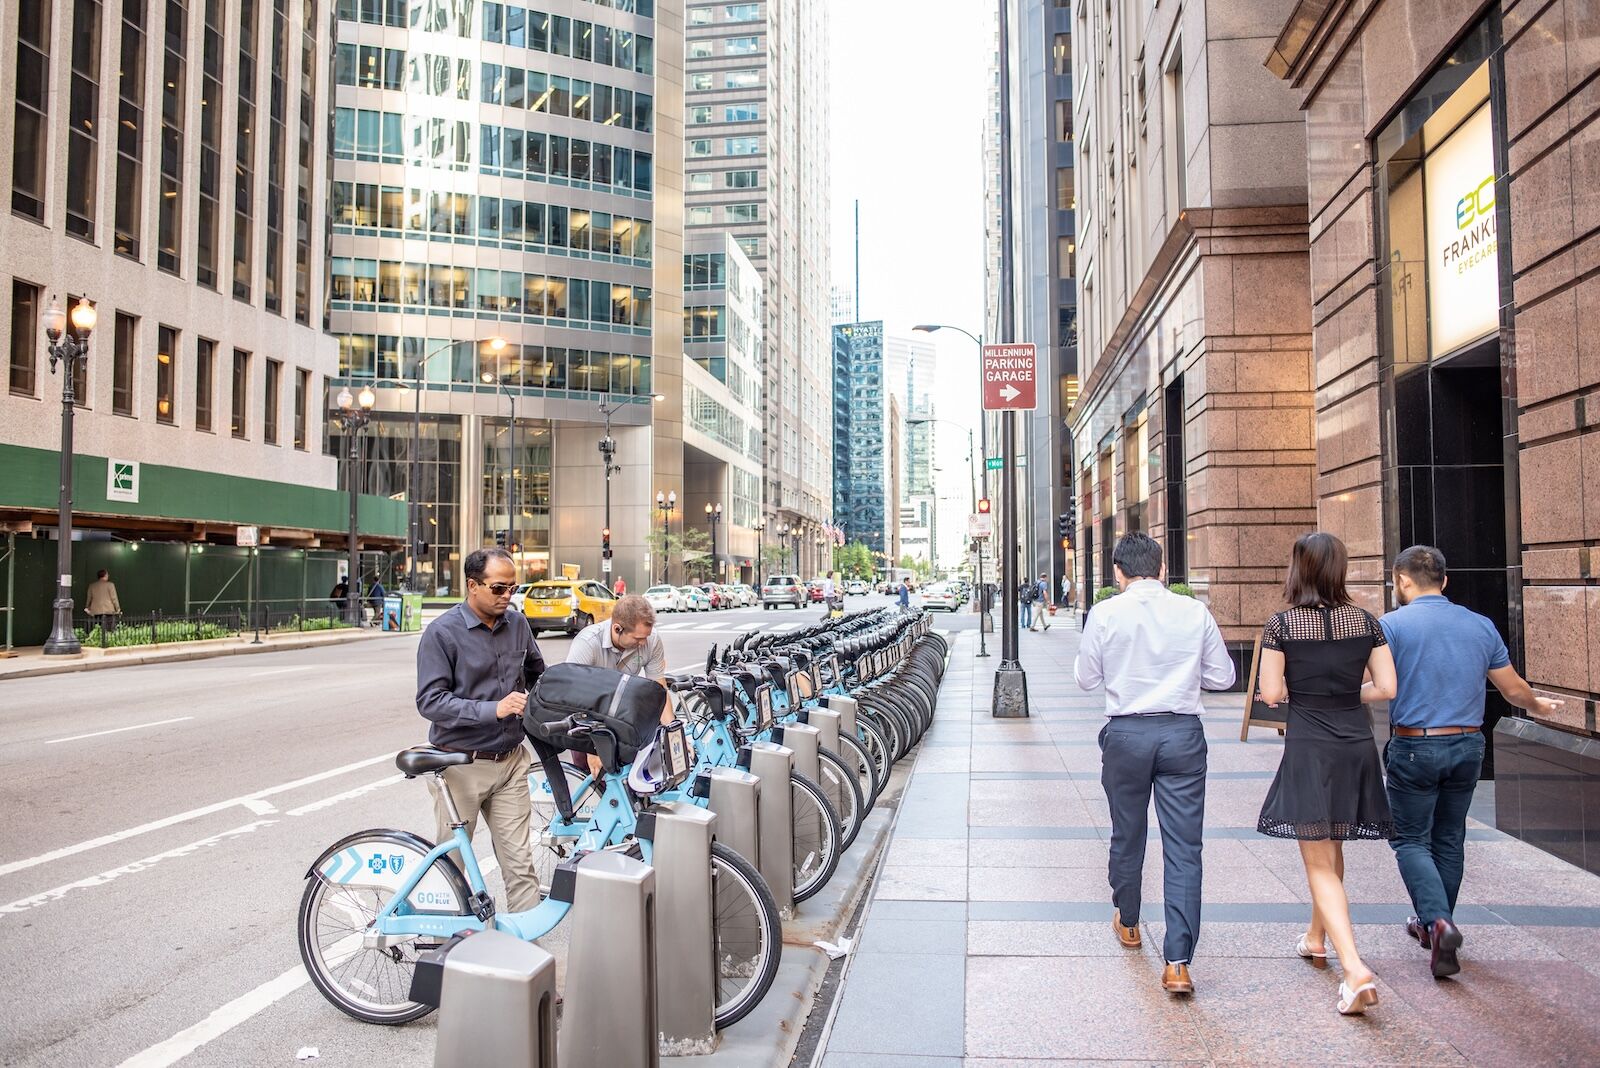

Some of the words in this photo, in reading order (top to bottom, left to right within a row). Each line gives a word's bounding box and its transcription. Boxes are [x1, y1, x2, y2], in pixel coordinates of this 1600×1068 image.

[984, 347, 1034, 357] MILLENNIUM
[985, 358, 1033, 370] PARKING
[986, 370, 1033, 382] GARAGE
[417, 892, 434, 904] GO
